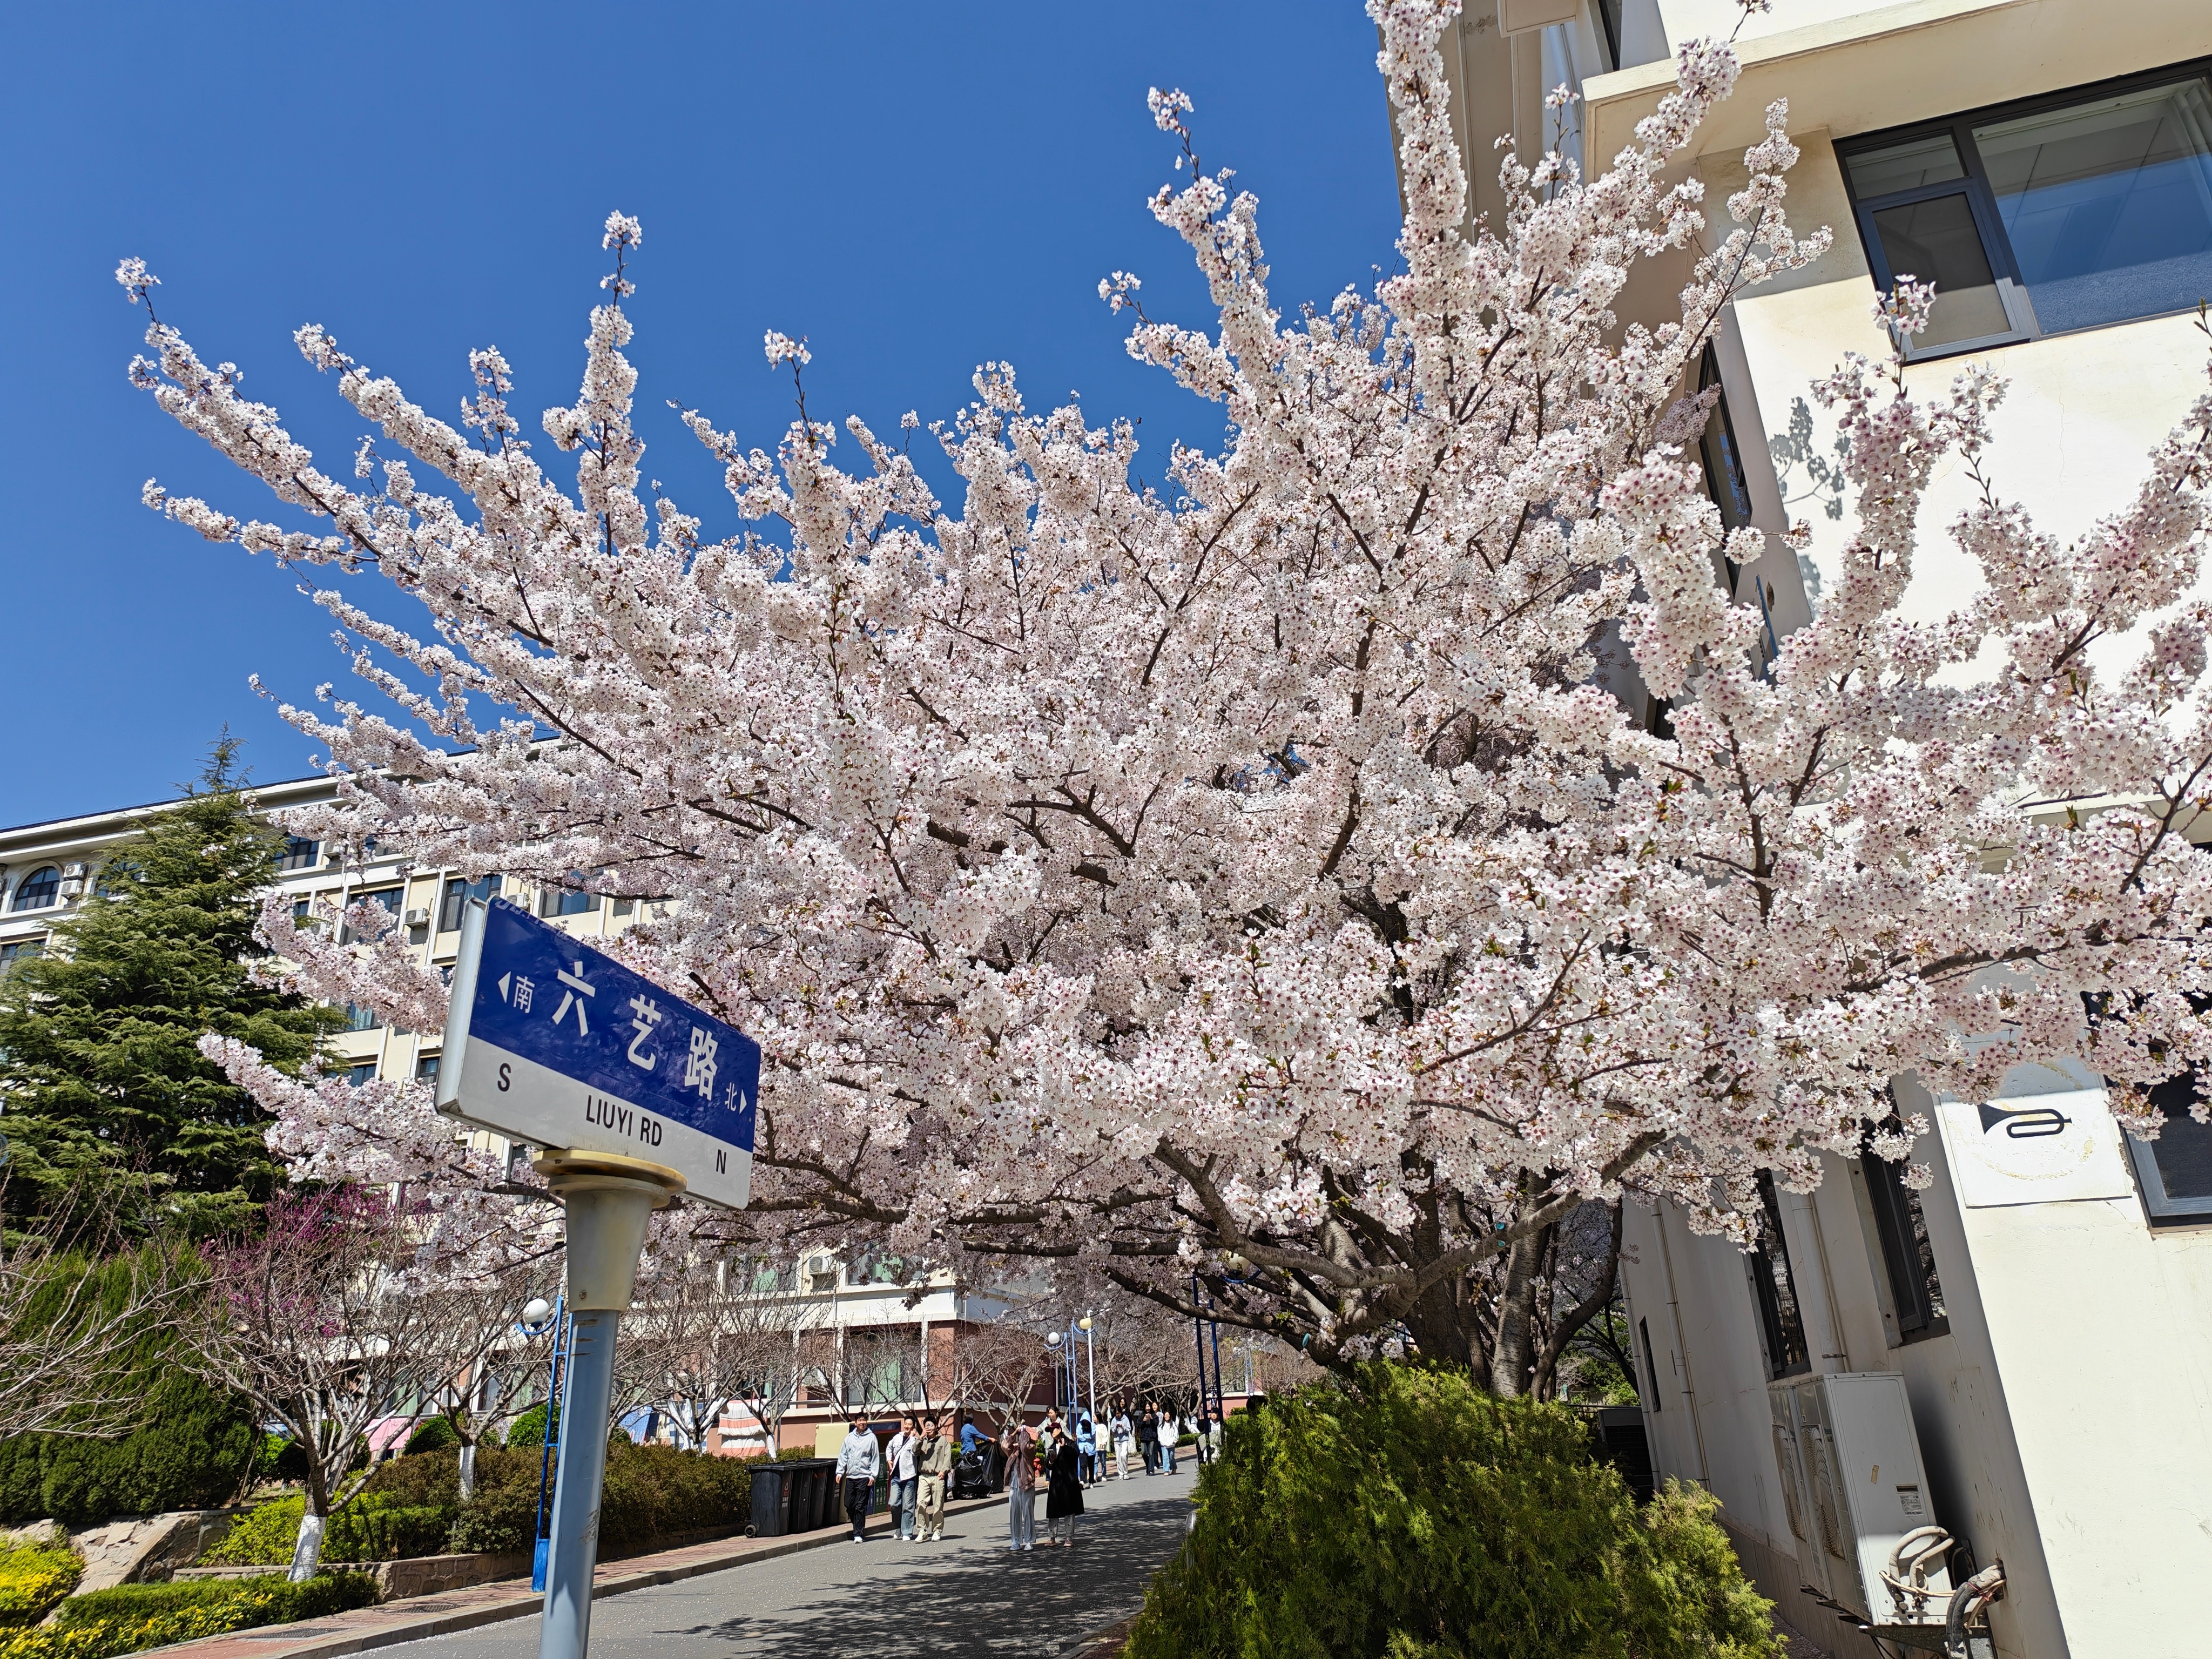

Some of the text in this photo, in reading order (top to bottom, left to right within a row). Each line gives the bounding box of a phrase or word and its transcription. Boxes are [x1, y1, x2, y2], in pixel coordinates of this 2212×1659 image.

[513, 961, 737, 1112] 南 六艺路 北
[497, 1063, 727, 1175] S LIUYI RD N
